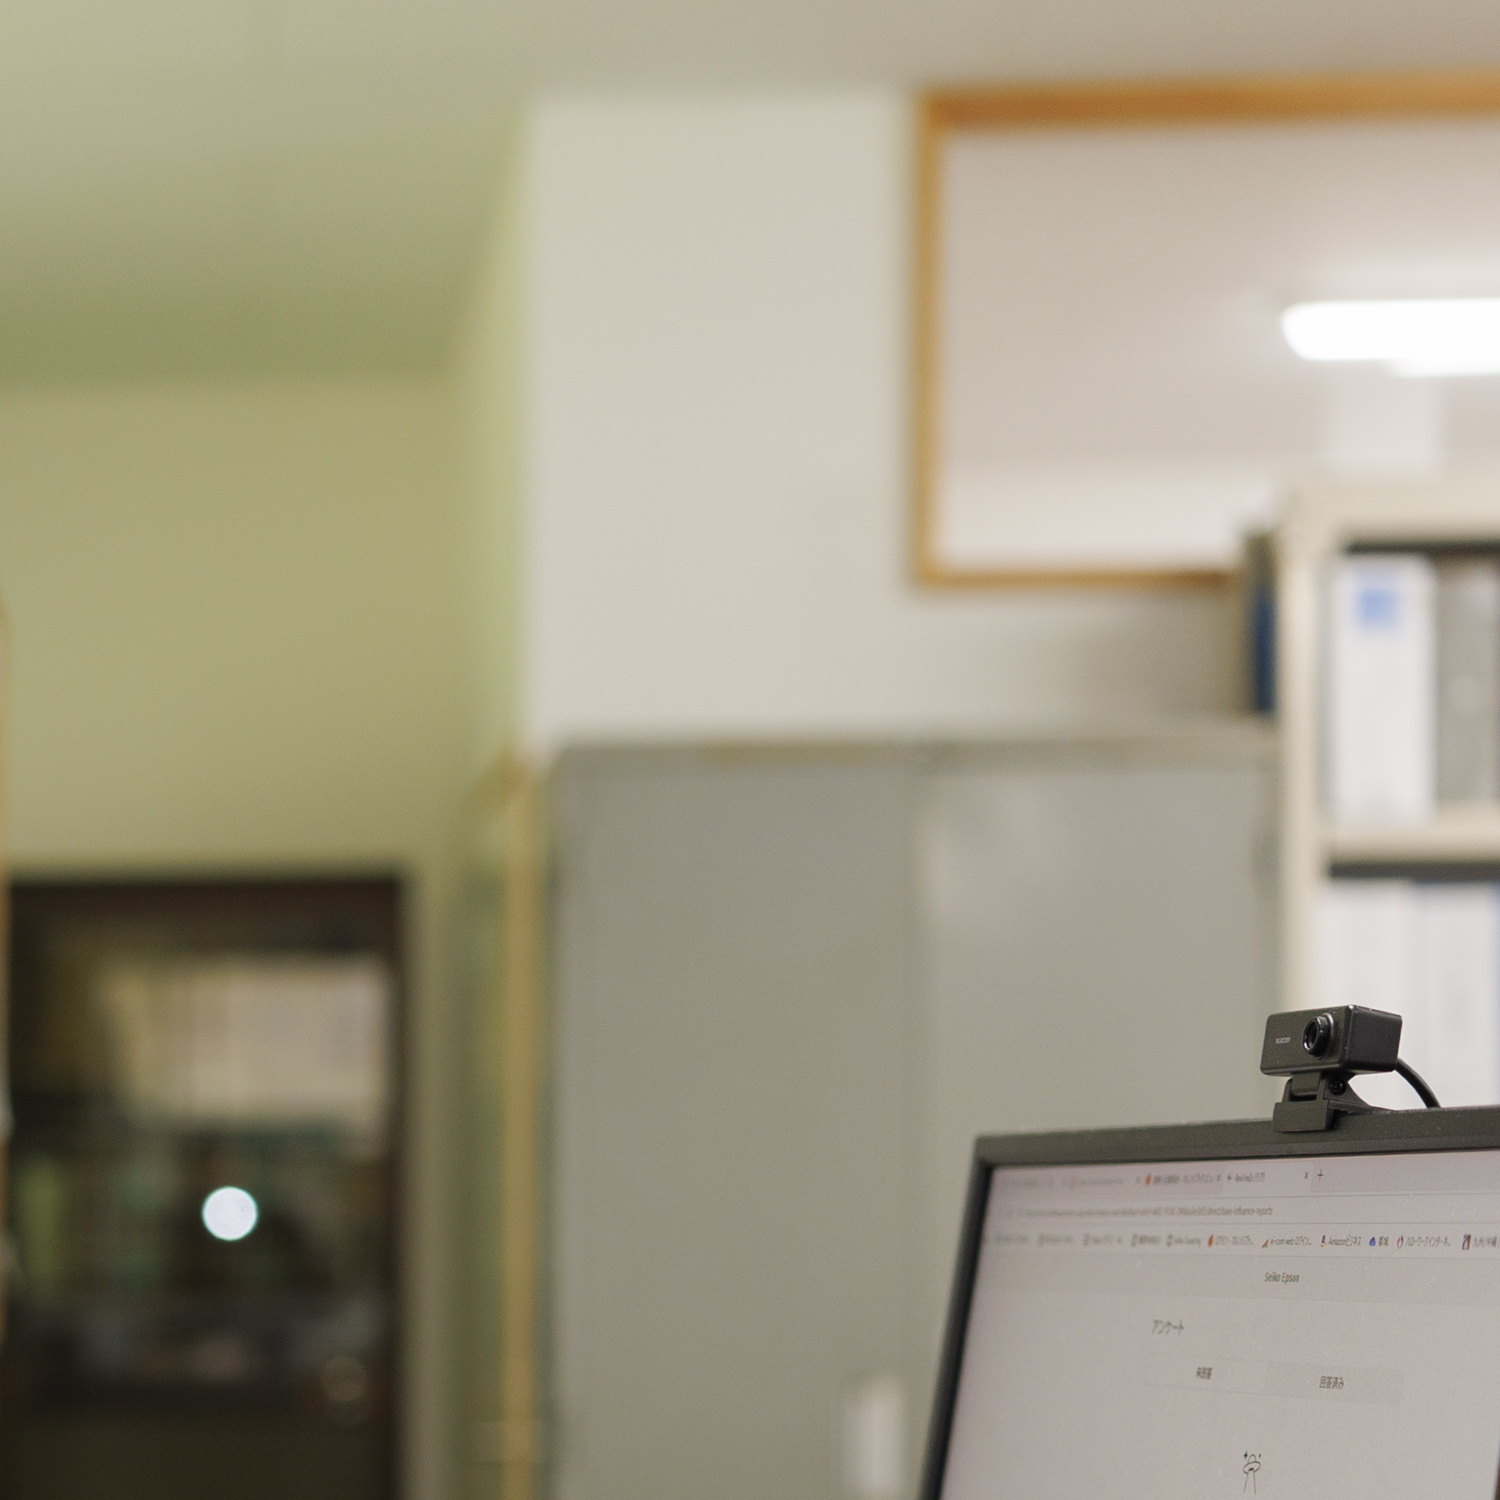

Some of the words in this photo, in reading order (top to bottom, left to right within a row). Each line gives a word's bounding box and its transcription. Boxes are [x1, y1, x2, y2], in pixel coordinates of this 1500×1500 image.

[1264, 1272, 1280, 1283] Seiko
[1281, 1272, 1300, 1284] Epson
[1152, 1319, 1185, 1335] アンケート
[1319, 1375, 1345, 1390] 回答済み
